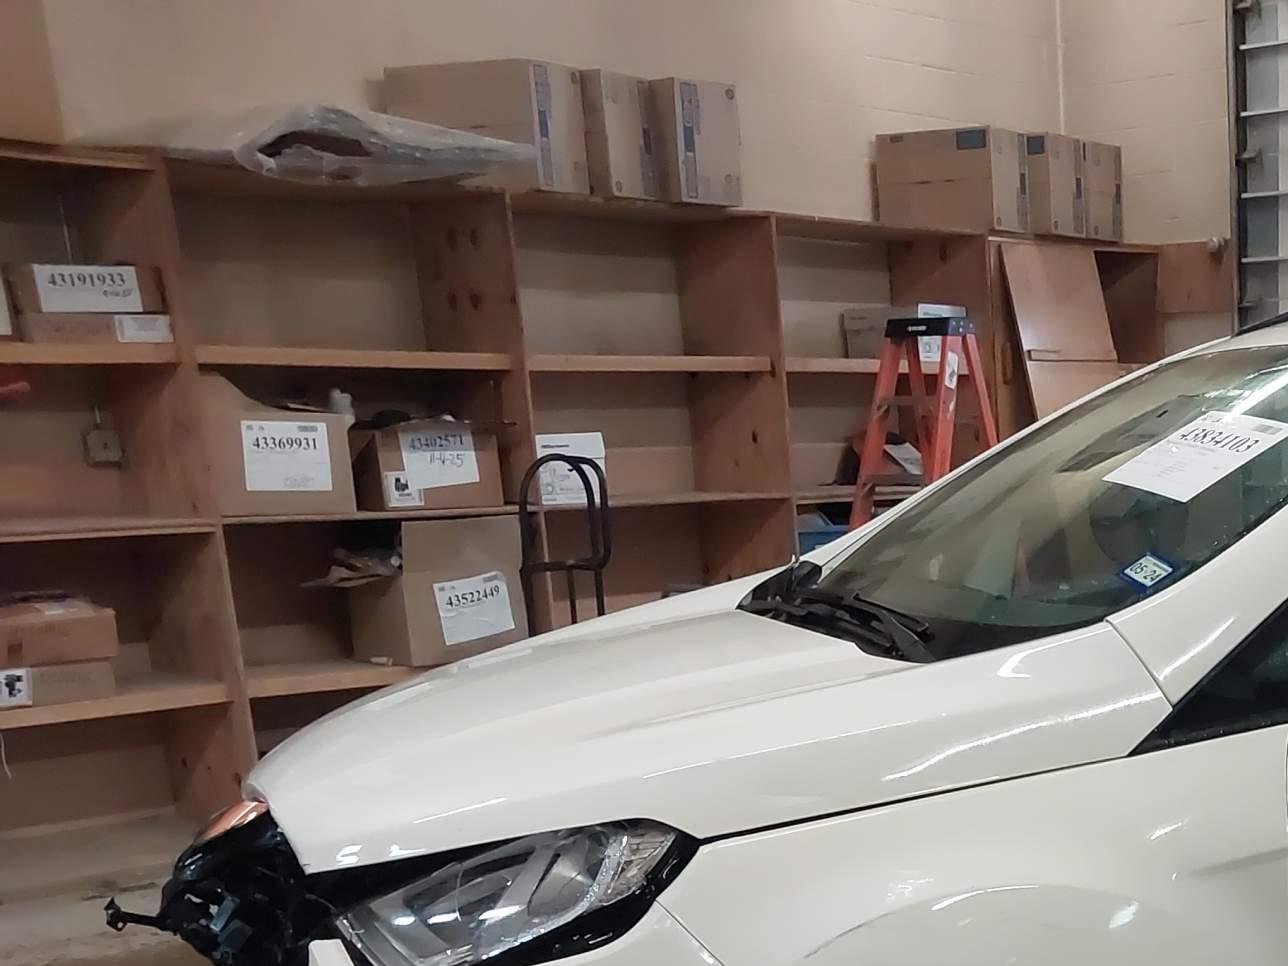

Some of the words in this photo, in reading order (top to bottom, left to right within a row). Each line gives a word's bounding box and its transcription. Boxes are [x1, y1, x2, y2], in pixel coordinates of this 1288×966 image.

[48, 272, 126, 287] 43191933
[252, 436, 318, 450] 43369931
[1180, 427, 1260, 453] 43834103
[445, 584, 500, 607] 43522449
